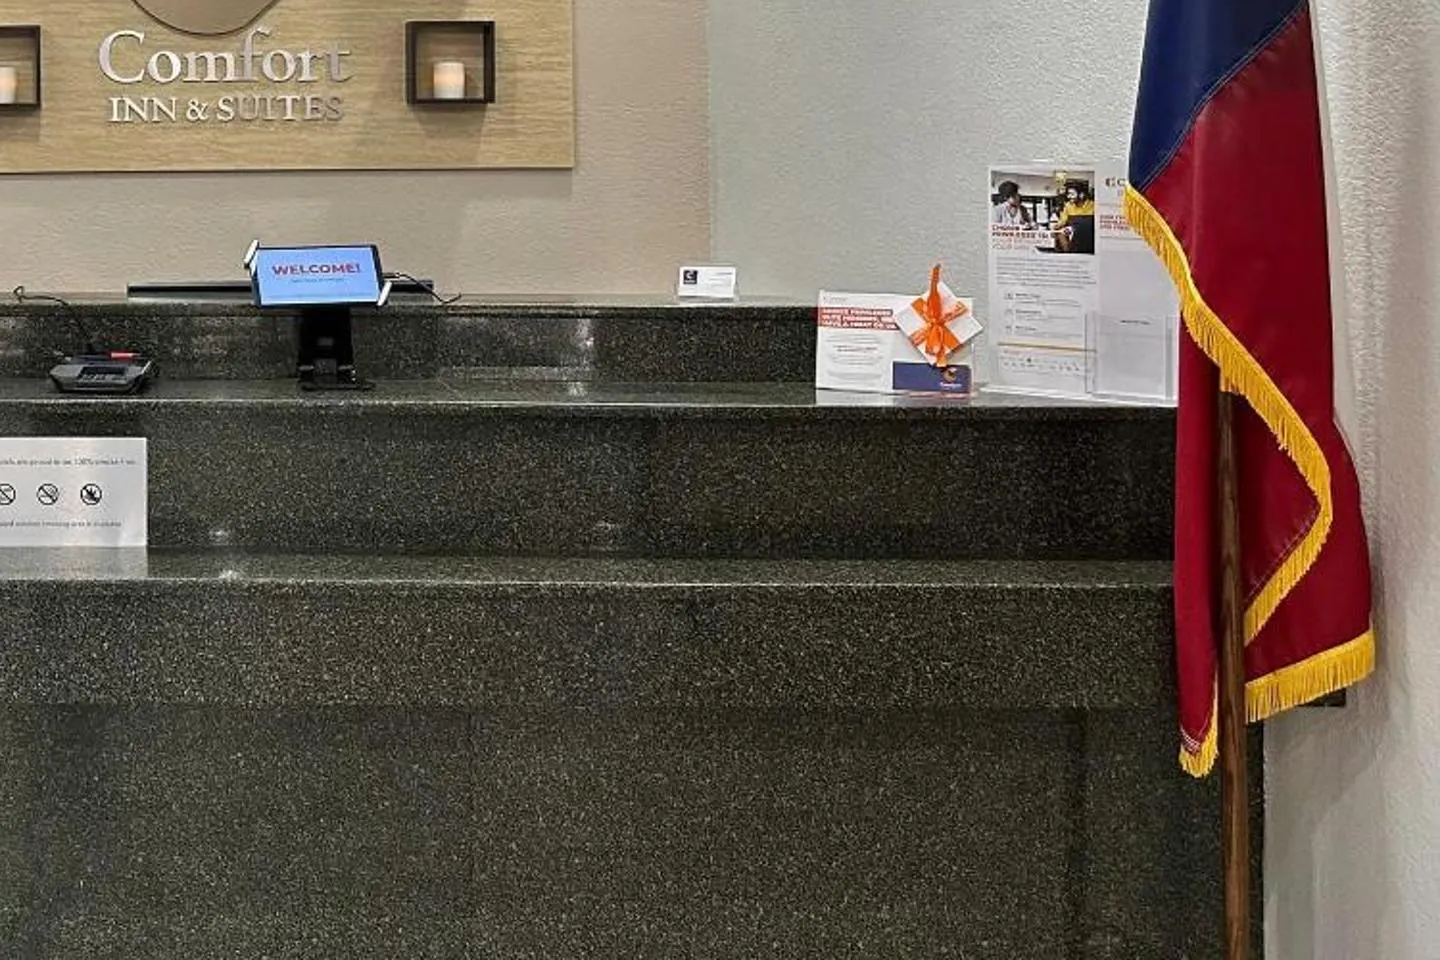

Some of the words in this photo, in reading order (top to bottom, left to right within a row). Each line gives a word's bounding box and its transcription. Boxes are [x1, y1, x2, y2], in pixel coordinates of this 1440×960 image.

[98, 27, 355, 84] Comfort
[109, 95, 177, 123] INN
[185, 98, 210, 122] &
[216, 94, 344, 123] SUITES
[271, 262, 362, 276] WELCOME!
